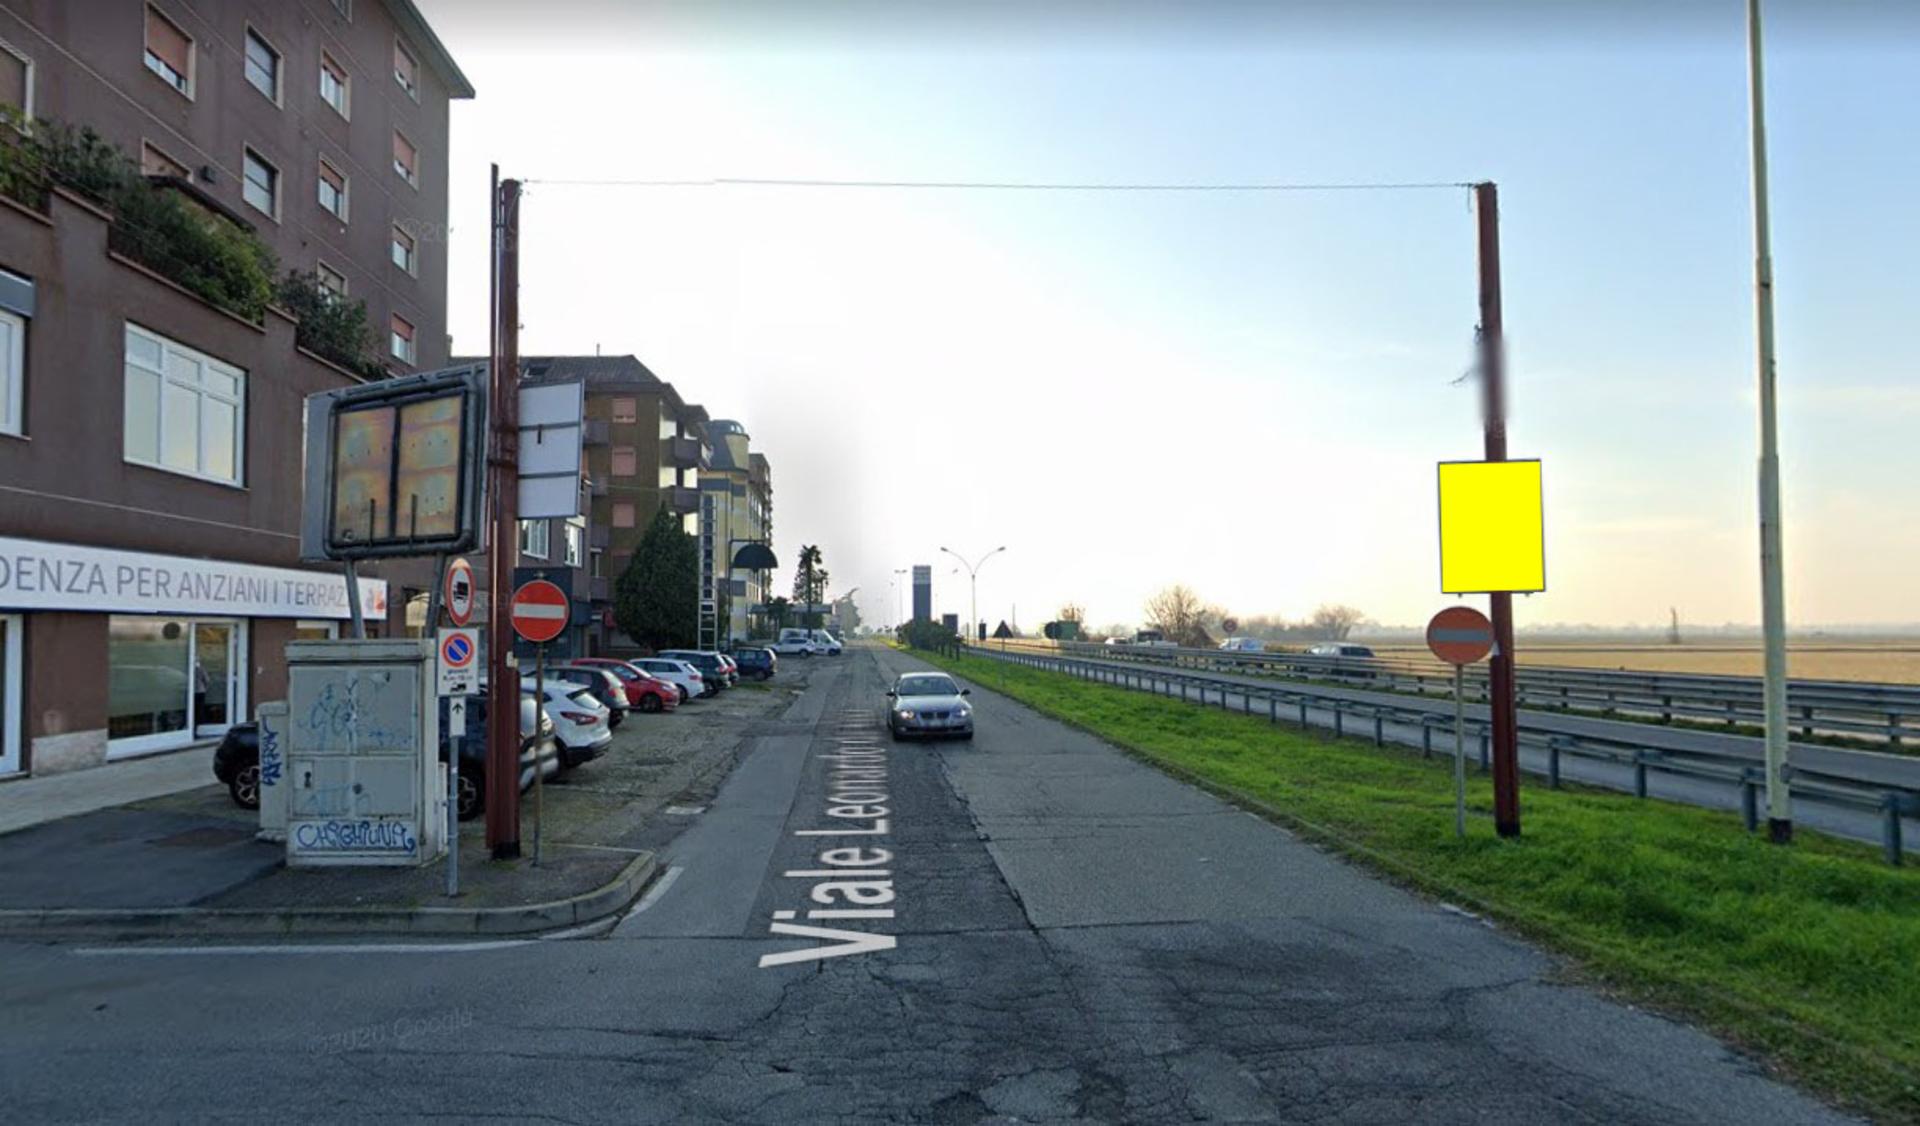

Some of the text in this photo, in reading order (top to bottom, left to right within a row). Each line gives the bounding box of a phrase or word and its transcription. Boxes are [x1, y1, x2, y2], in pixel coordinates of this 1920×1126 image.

[117, 565, 170, 598] PER
[177, 571, 268, 604] ANZIANI
[284, 580, 349, 608] TERRAZ
